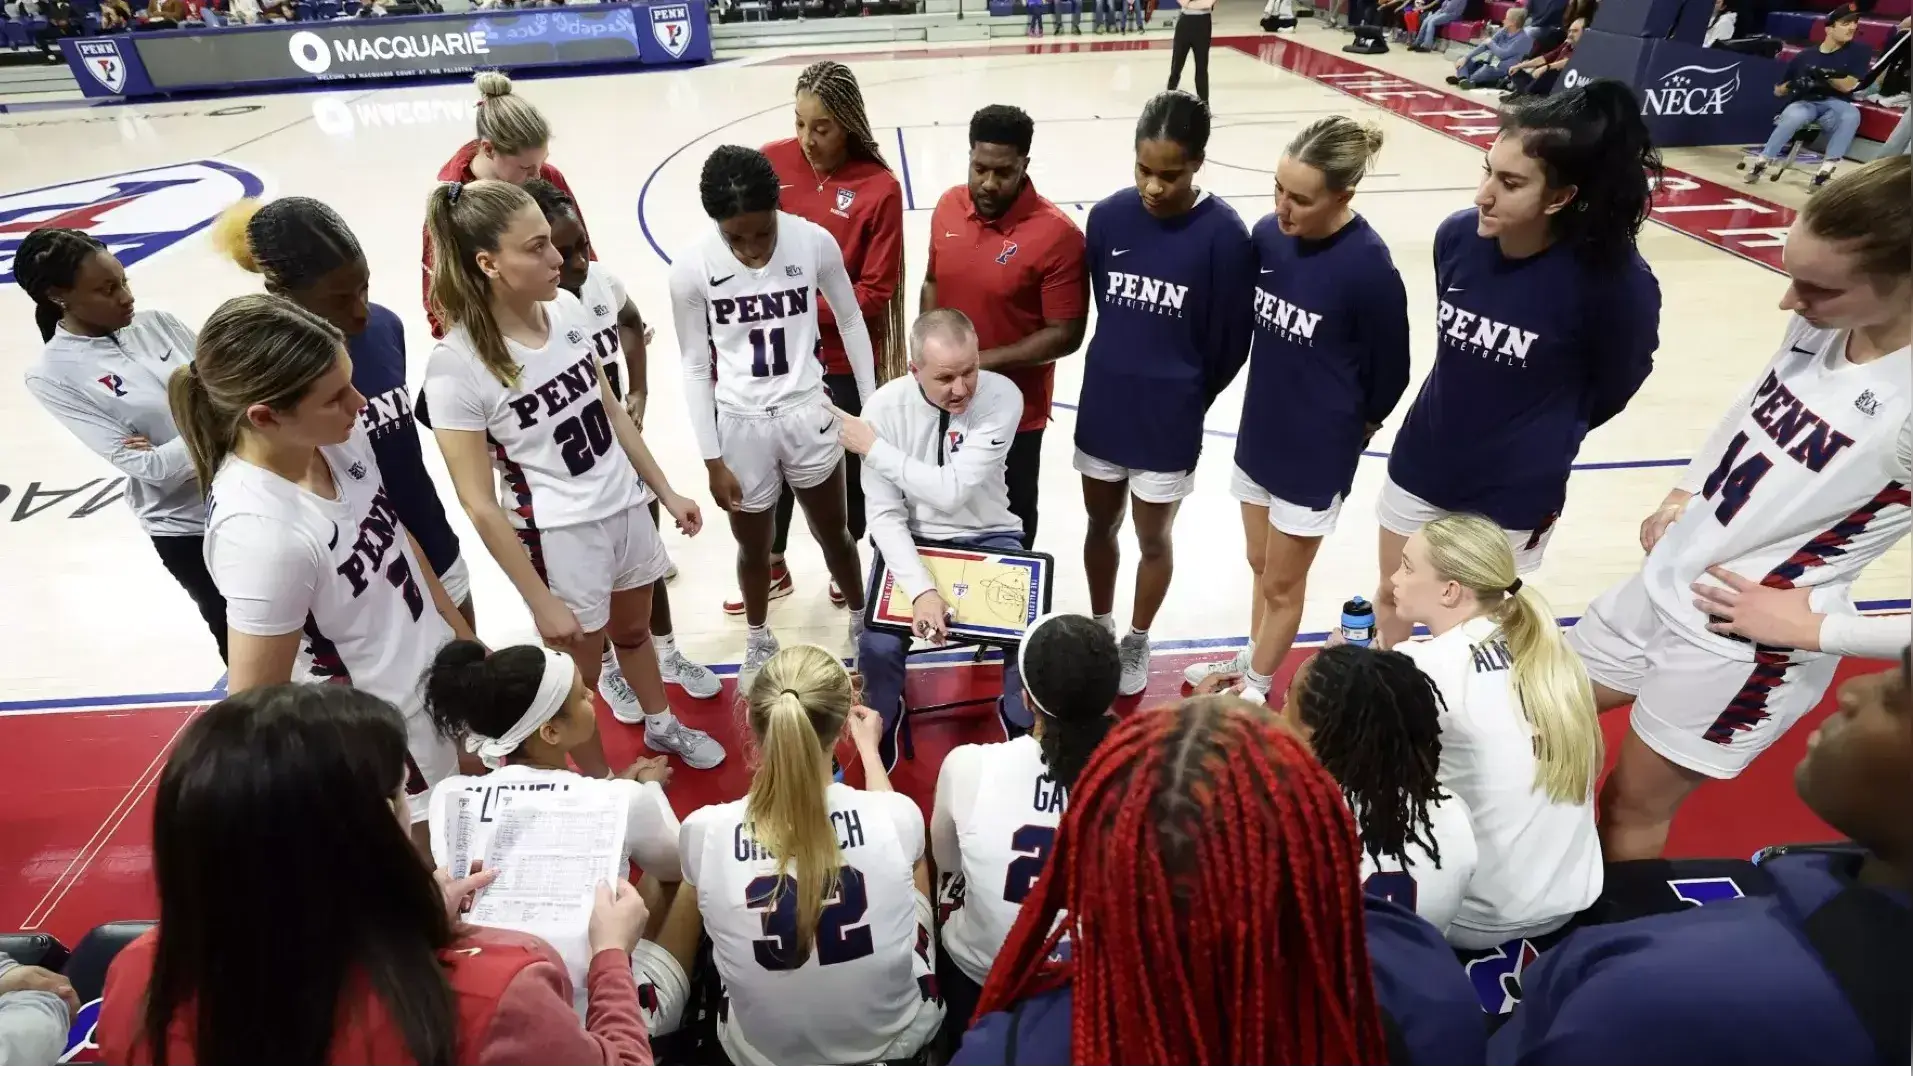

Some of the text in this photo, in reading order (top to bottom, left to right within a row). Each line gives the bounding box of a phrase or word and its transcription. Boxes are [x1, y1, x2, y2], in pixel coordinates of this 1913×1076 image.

[653, 8, 685, 20] PENN
[80, 43, 116, 54] PENN
[333, 31, 490, 62] MACQUARIE
[1640, 87, 1724, 116] NECA
[712, 286, 809, 325] PENN
[1107, 271, 1189, 310] PENN
[1253, 286, 1323, 339] PENN
[748, 327, 789, 378] 11
[1437, 299, 1540, 360] PENN
[508, 352, 600, 431] PENN
[552, 398, 613, 477] 20
[1750, 367, 1856, 473] PENN
[1702, 430, 1774, 527] 14
[745, 865, 874, 971] 32
